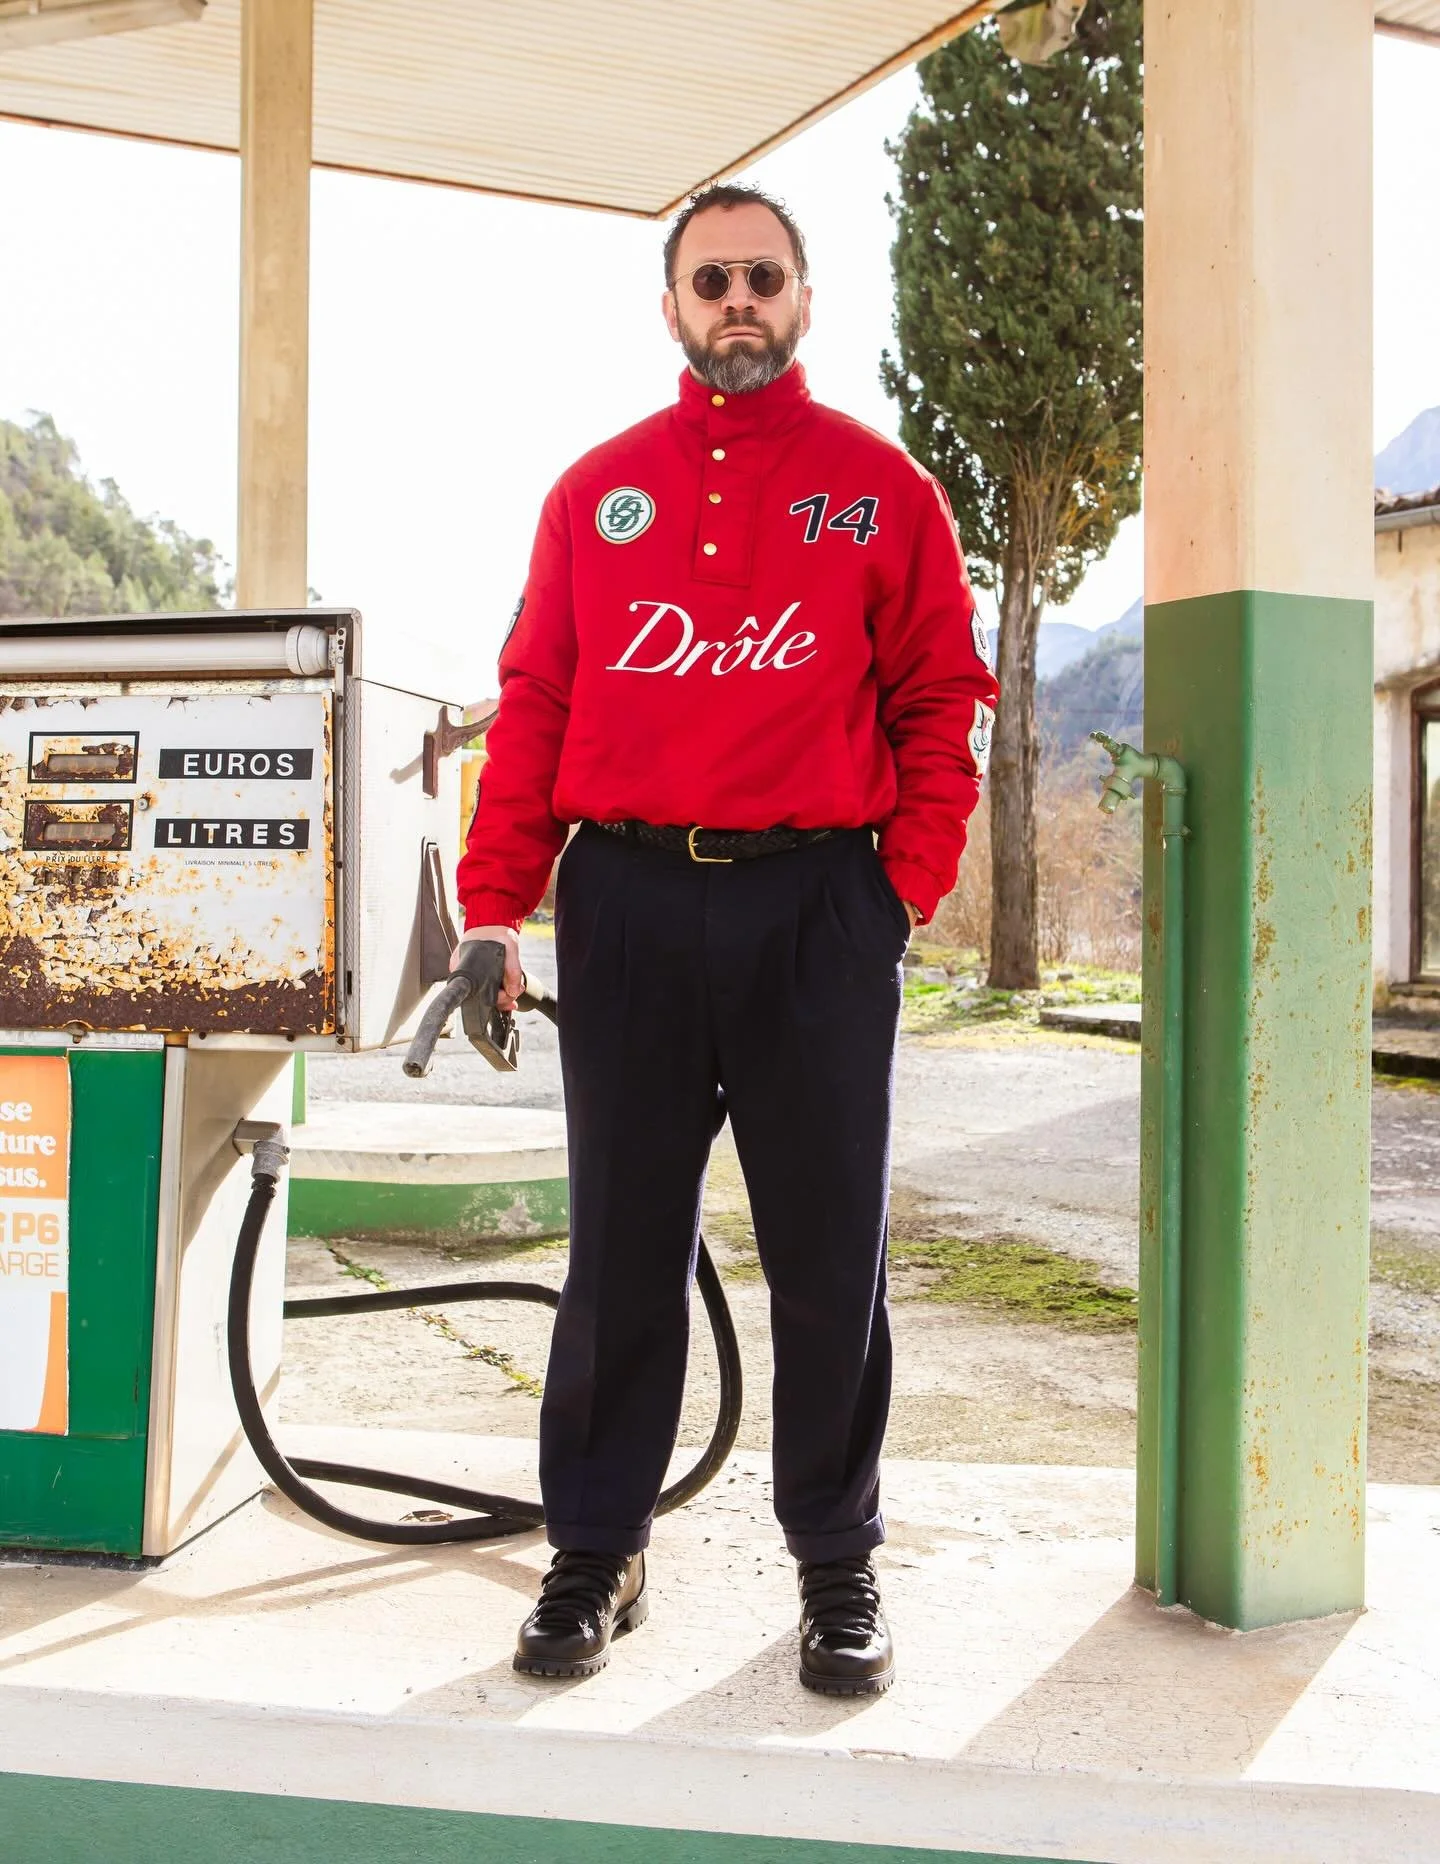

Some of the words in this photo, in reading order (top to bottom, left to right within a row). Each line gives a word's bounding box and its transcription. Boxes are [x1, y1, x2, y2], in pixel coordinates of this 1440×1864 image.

[788, 493, 880, 545] 14
[605, 600, 818, 677] Drôle
[183, 753, 295, 777] EUROS
[168, 823, 296, 846] LITRES
[46, 855, 66, 863] PRIX
